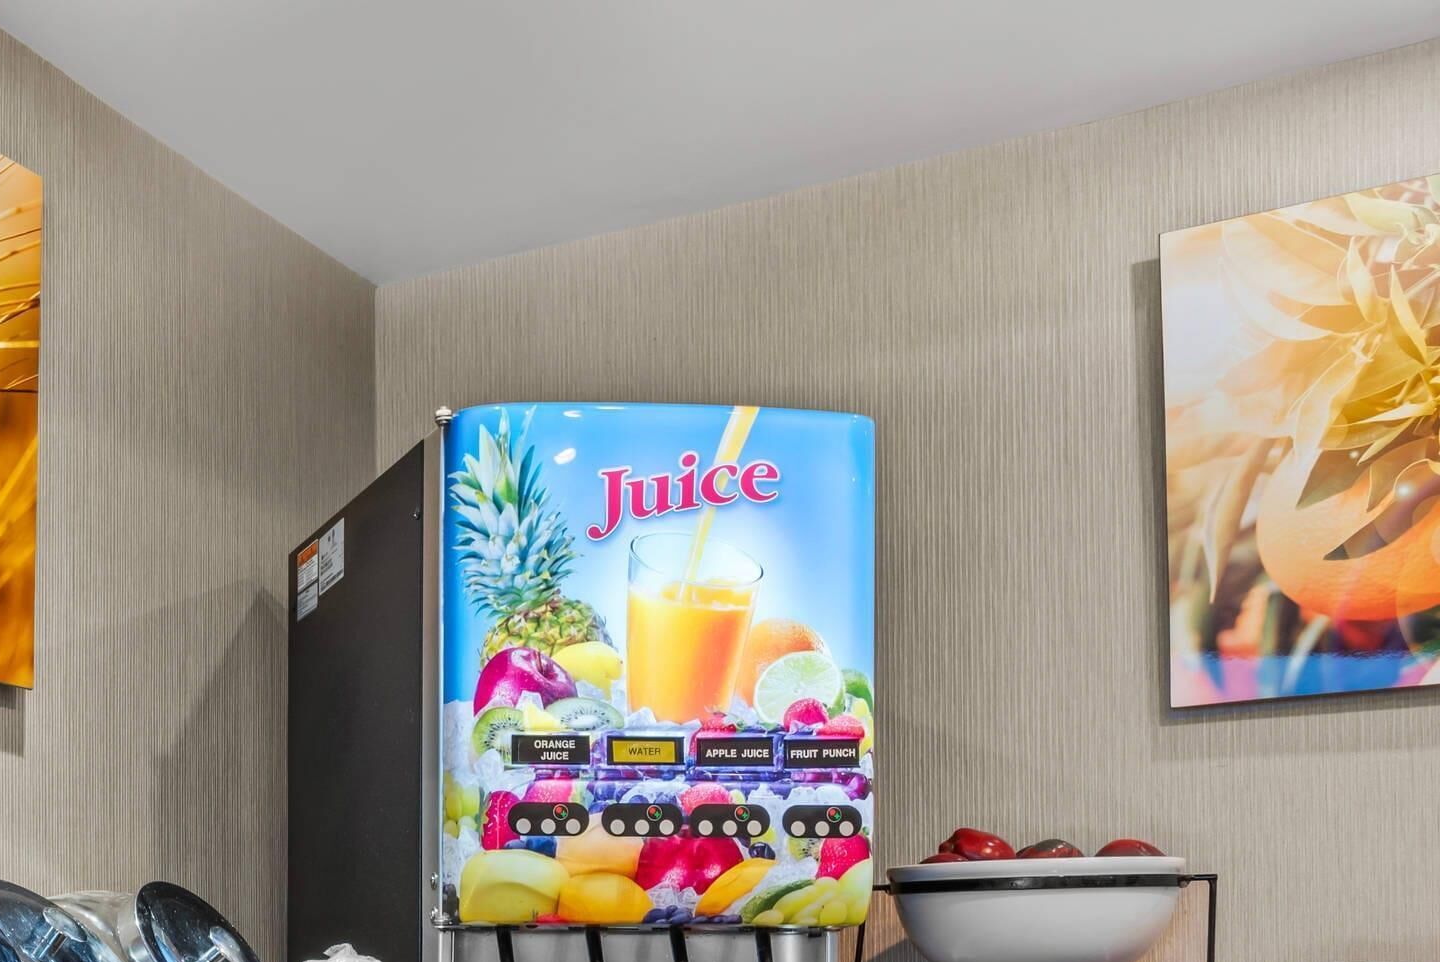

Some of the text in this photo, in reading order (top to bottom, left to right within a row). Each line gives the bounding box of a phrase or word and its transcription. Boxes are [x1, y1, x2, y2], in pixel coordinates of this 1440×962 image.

[585, 450, 781, 540] Juice
[533, 739, 576, 749] ORANGE
[540, 751, 569, 761] JUICE
[628, 747, 661, 755] WATER
[705, 749, 770, 758] APPLE JUICE
[790, 748, 856, 759] FRUIT PUNCH
